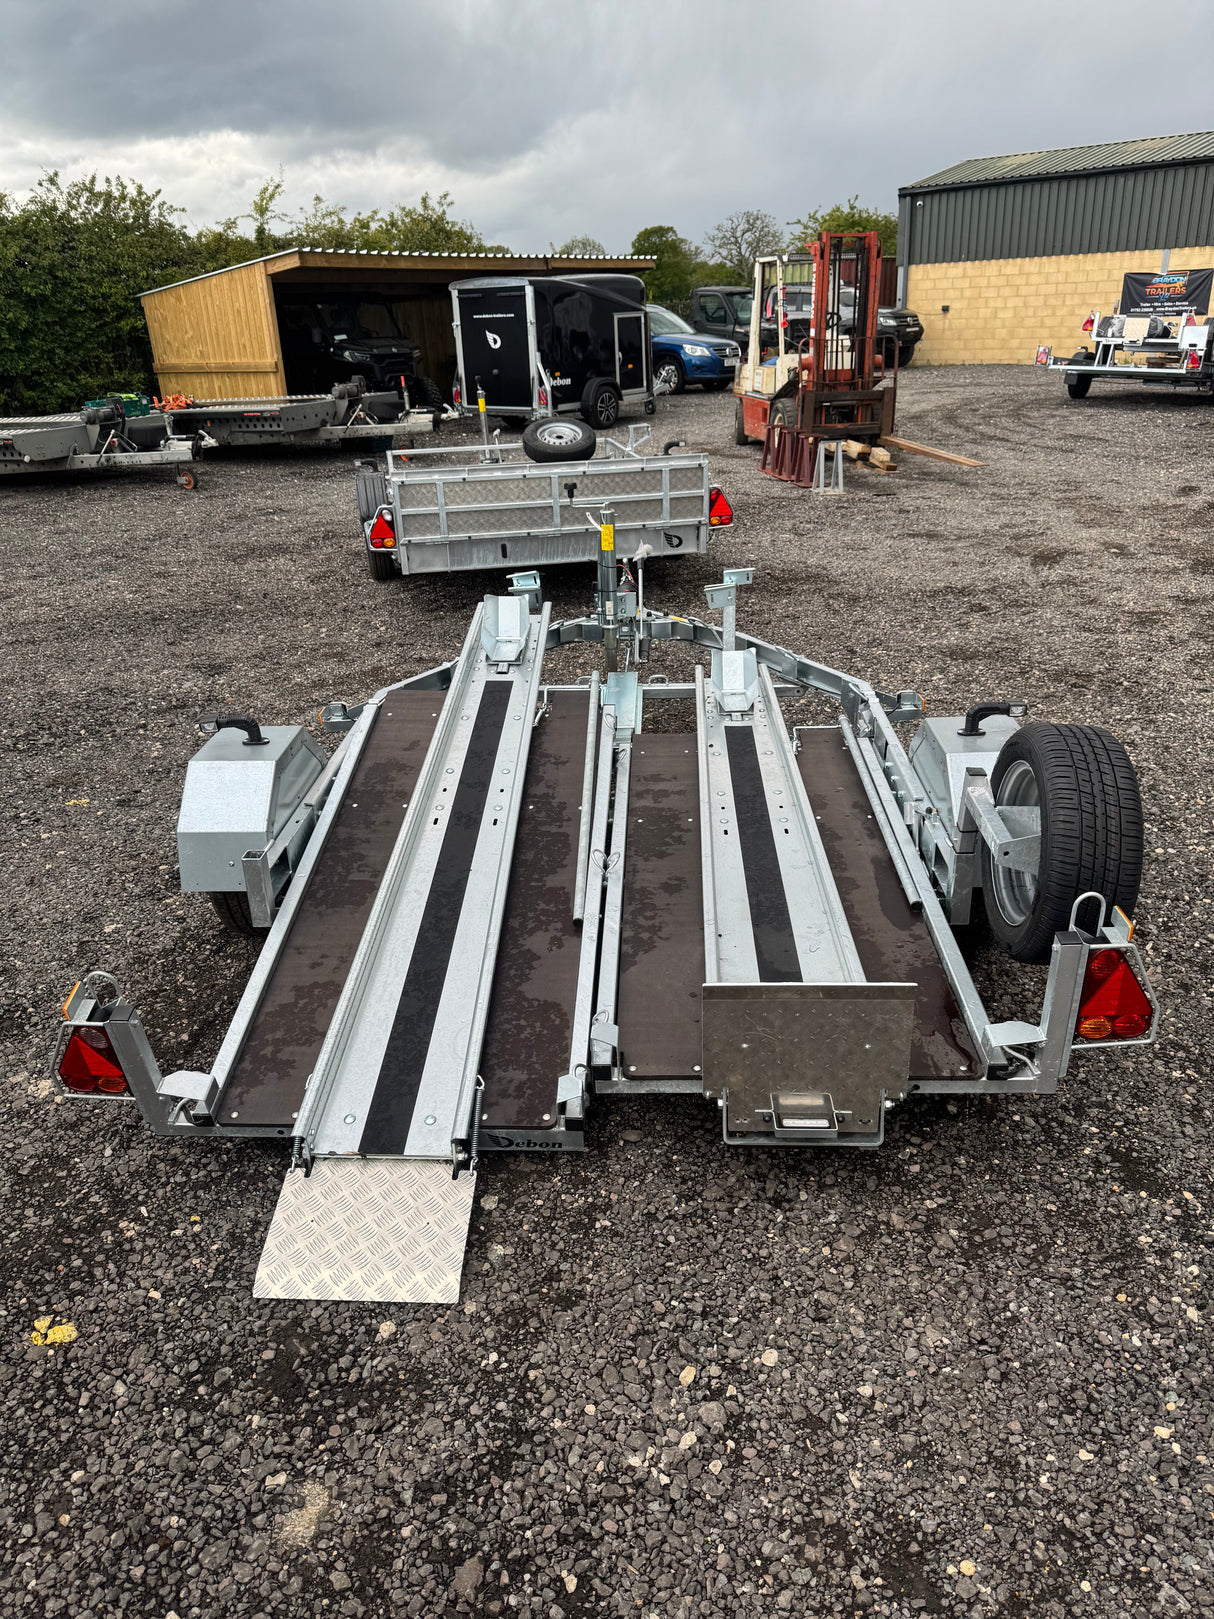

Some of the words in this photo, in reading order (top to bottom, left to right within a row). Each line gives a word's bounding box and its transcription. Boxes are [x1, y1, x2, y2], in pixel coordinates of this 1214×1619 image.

[1152, 276, 1187, 284] BRAYDON
[1145, 287, 1187, 296] TRAILERS
[487, 1133, 563, 1149] Debon
